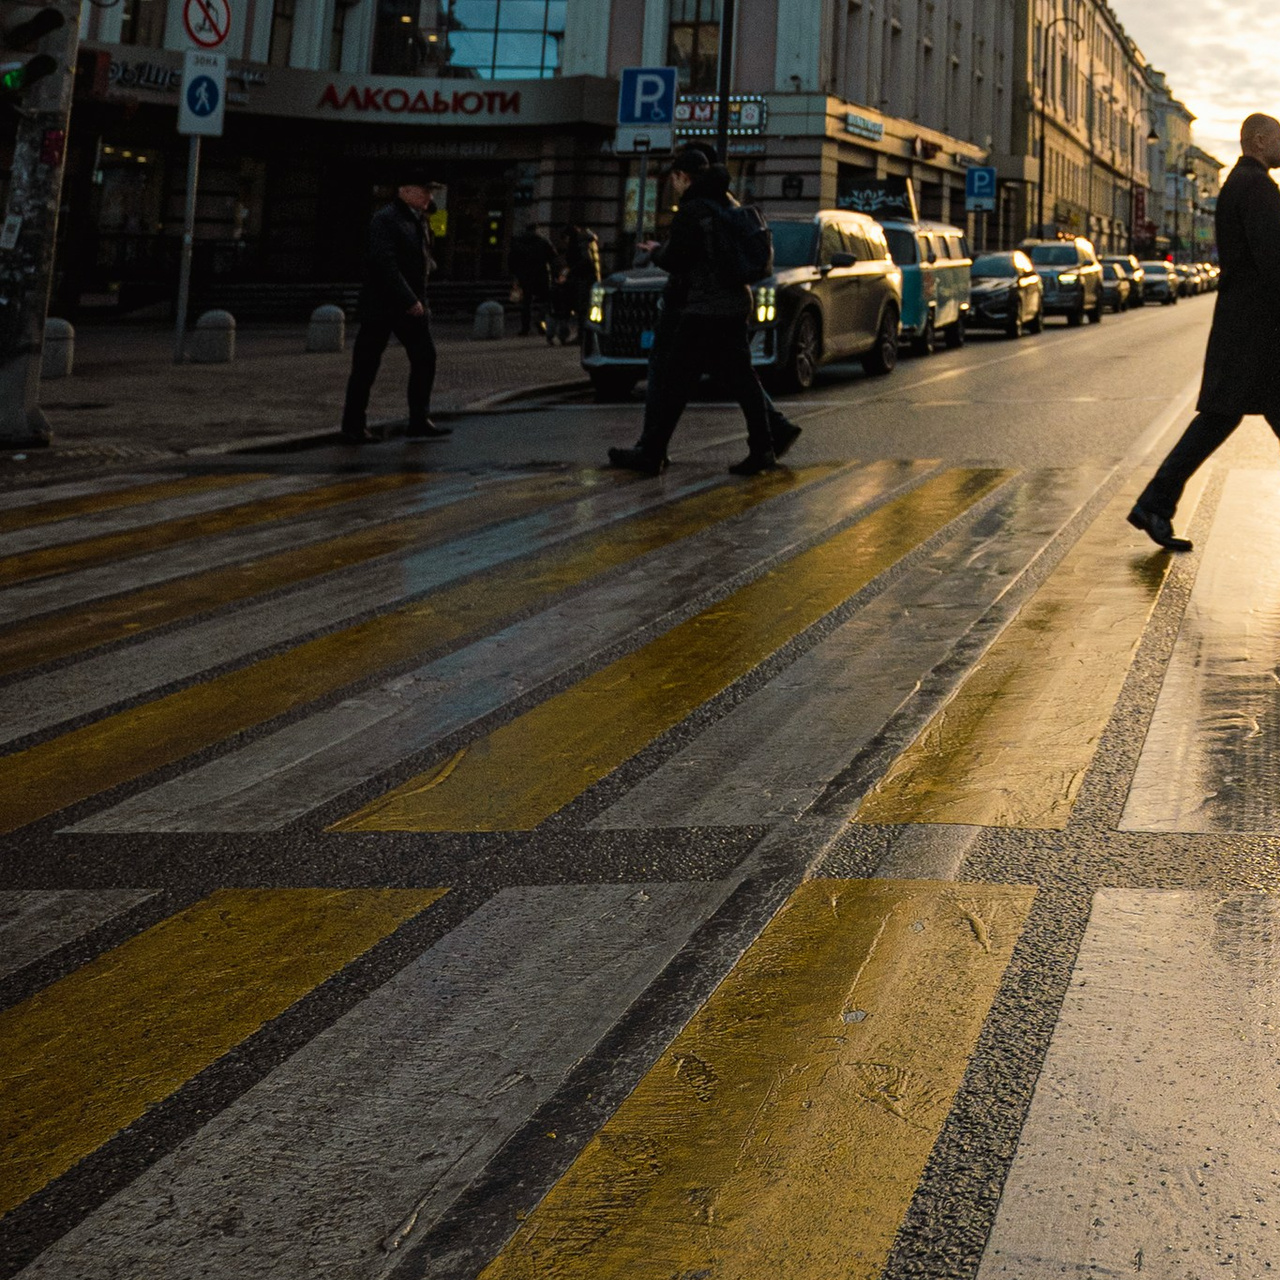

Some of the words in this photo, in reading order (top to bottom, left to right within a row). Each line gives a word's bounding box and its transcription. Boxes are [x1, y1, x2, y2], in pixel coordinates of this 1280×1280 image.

[194, 54, 218, 67] ЗОНА
[319, 83, 520, 114] АЛКОДЬЮТИ
[634, 74, 665, 118] P
[974, 171, 990, 193] P
